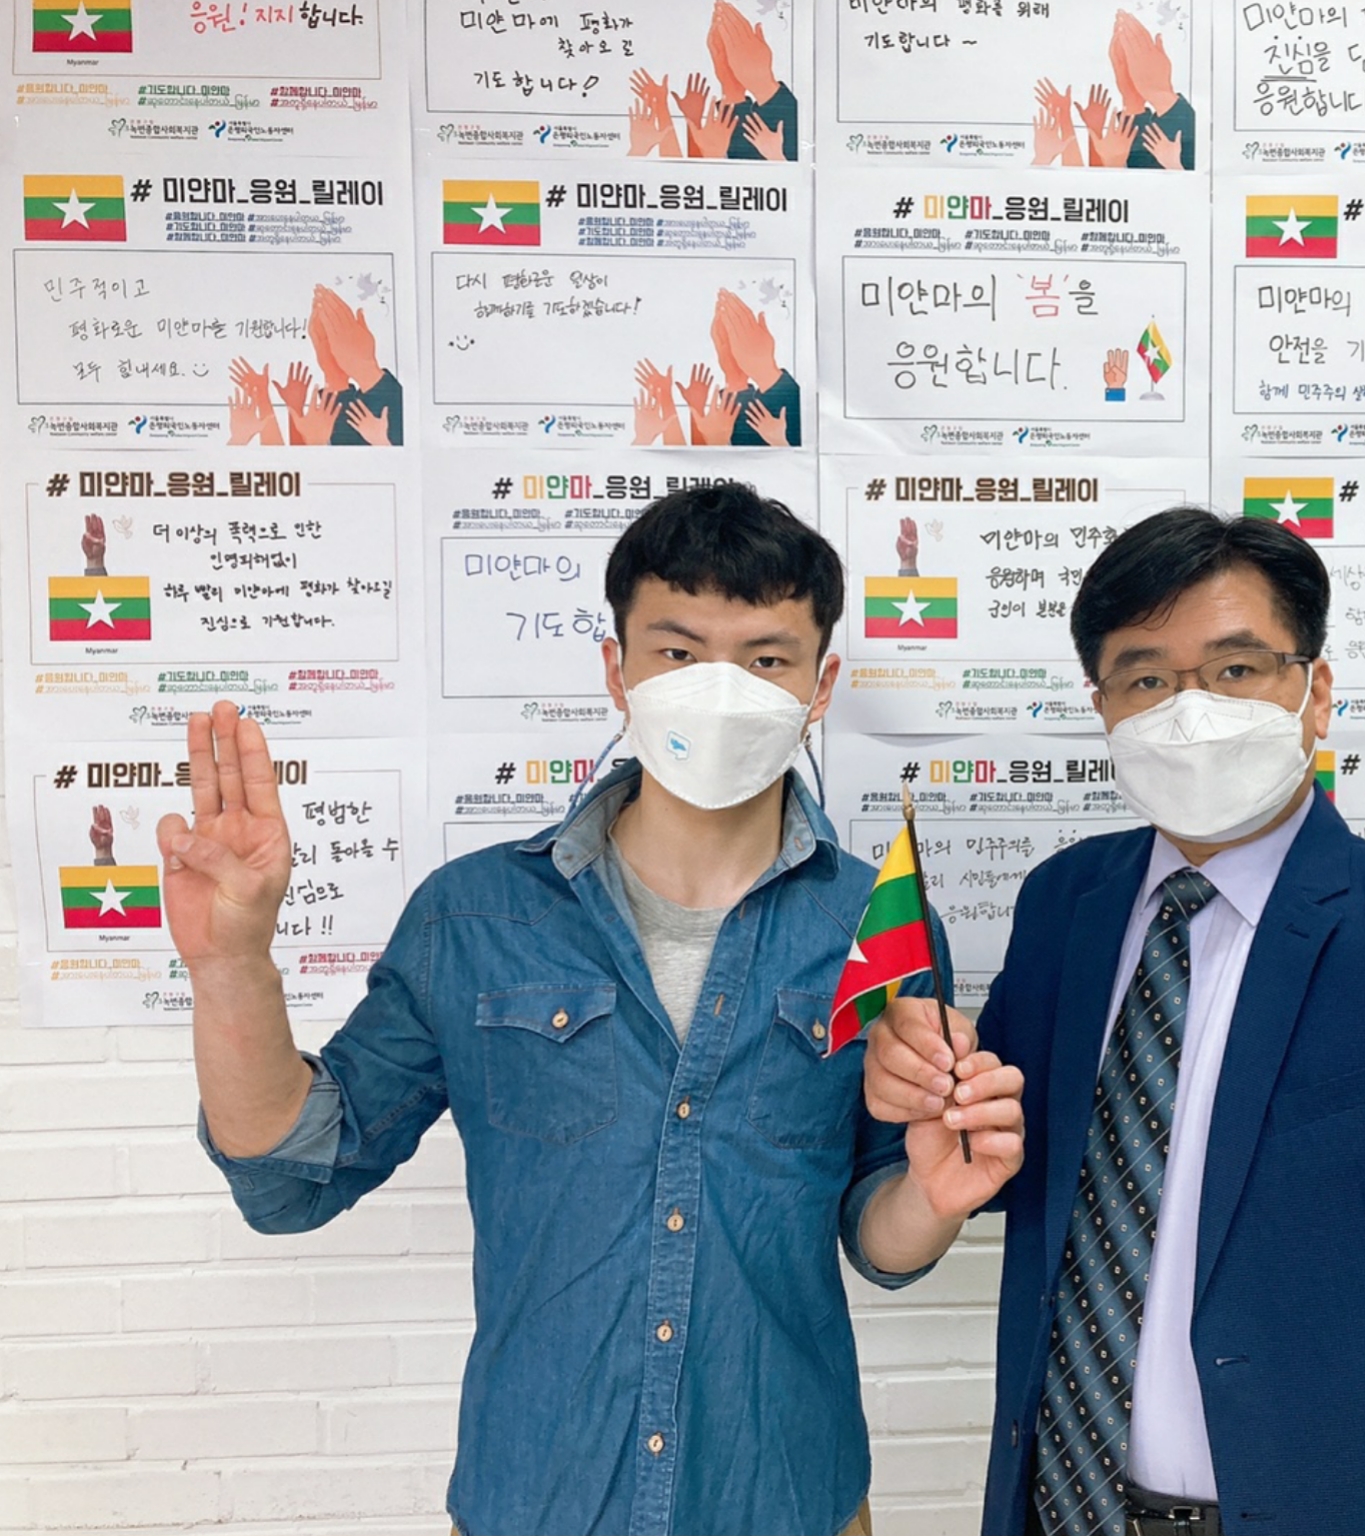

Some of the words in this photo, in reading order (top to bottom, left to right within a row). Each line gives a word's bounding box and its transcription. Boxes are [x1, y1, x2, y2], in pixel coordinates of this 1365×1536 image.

[255, 5, 293, 23] 지지
[1243, 2, 1347, 31] 미얀마의
[130, 179, 152, 202] #
[163, 178, 383, 205] 미얀마_응원_릴레이
[546, 185, 567, 207] #
[577, 183, 786, 211] 미얀마_응원_릴레이
[893, 197, 914, 218] #
[925, 196, 1128, 223] 미얀마_응원_릴레이
[1344, 199, 1364, 221] #
[862, 274, 996, 321] 미얀마의
[1258, 285, 1350, 317] 미얀마의
[69, 318, 142, 341] 평화로운
[1269, 334, 1327, 364] 안전을
[887, 341, 1067, 390] 응원합니다.
[46, 474, 70, 497] #
[80, 472, 300, 497] 미얀마_응원_릴레이
[228, 521, 287, 544] 폭력으로
